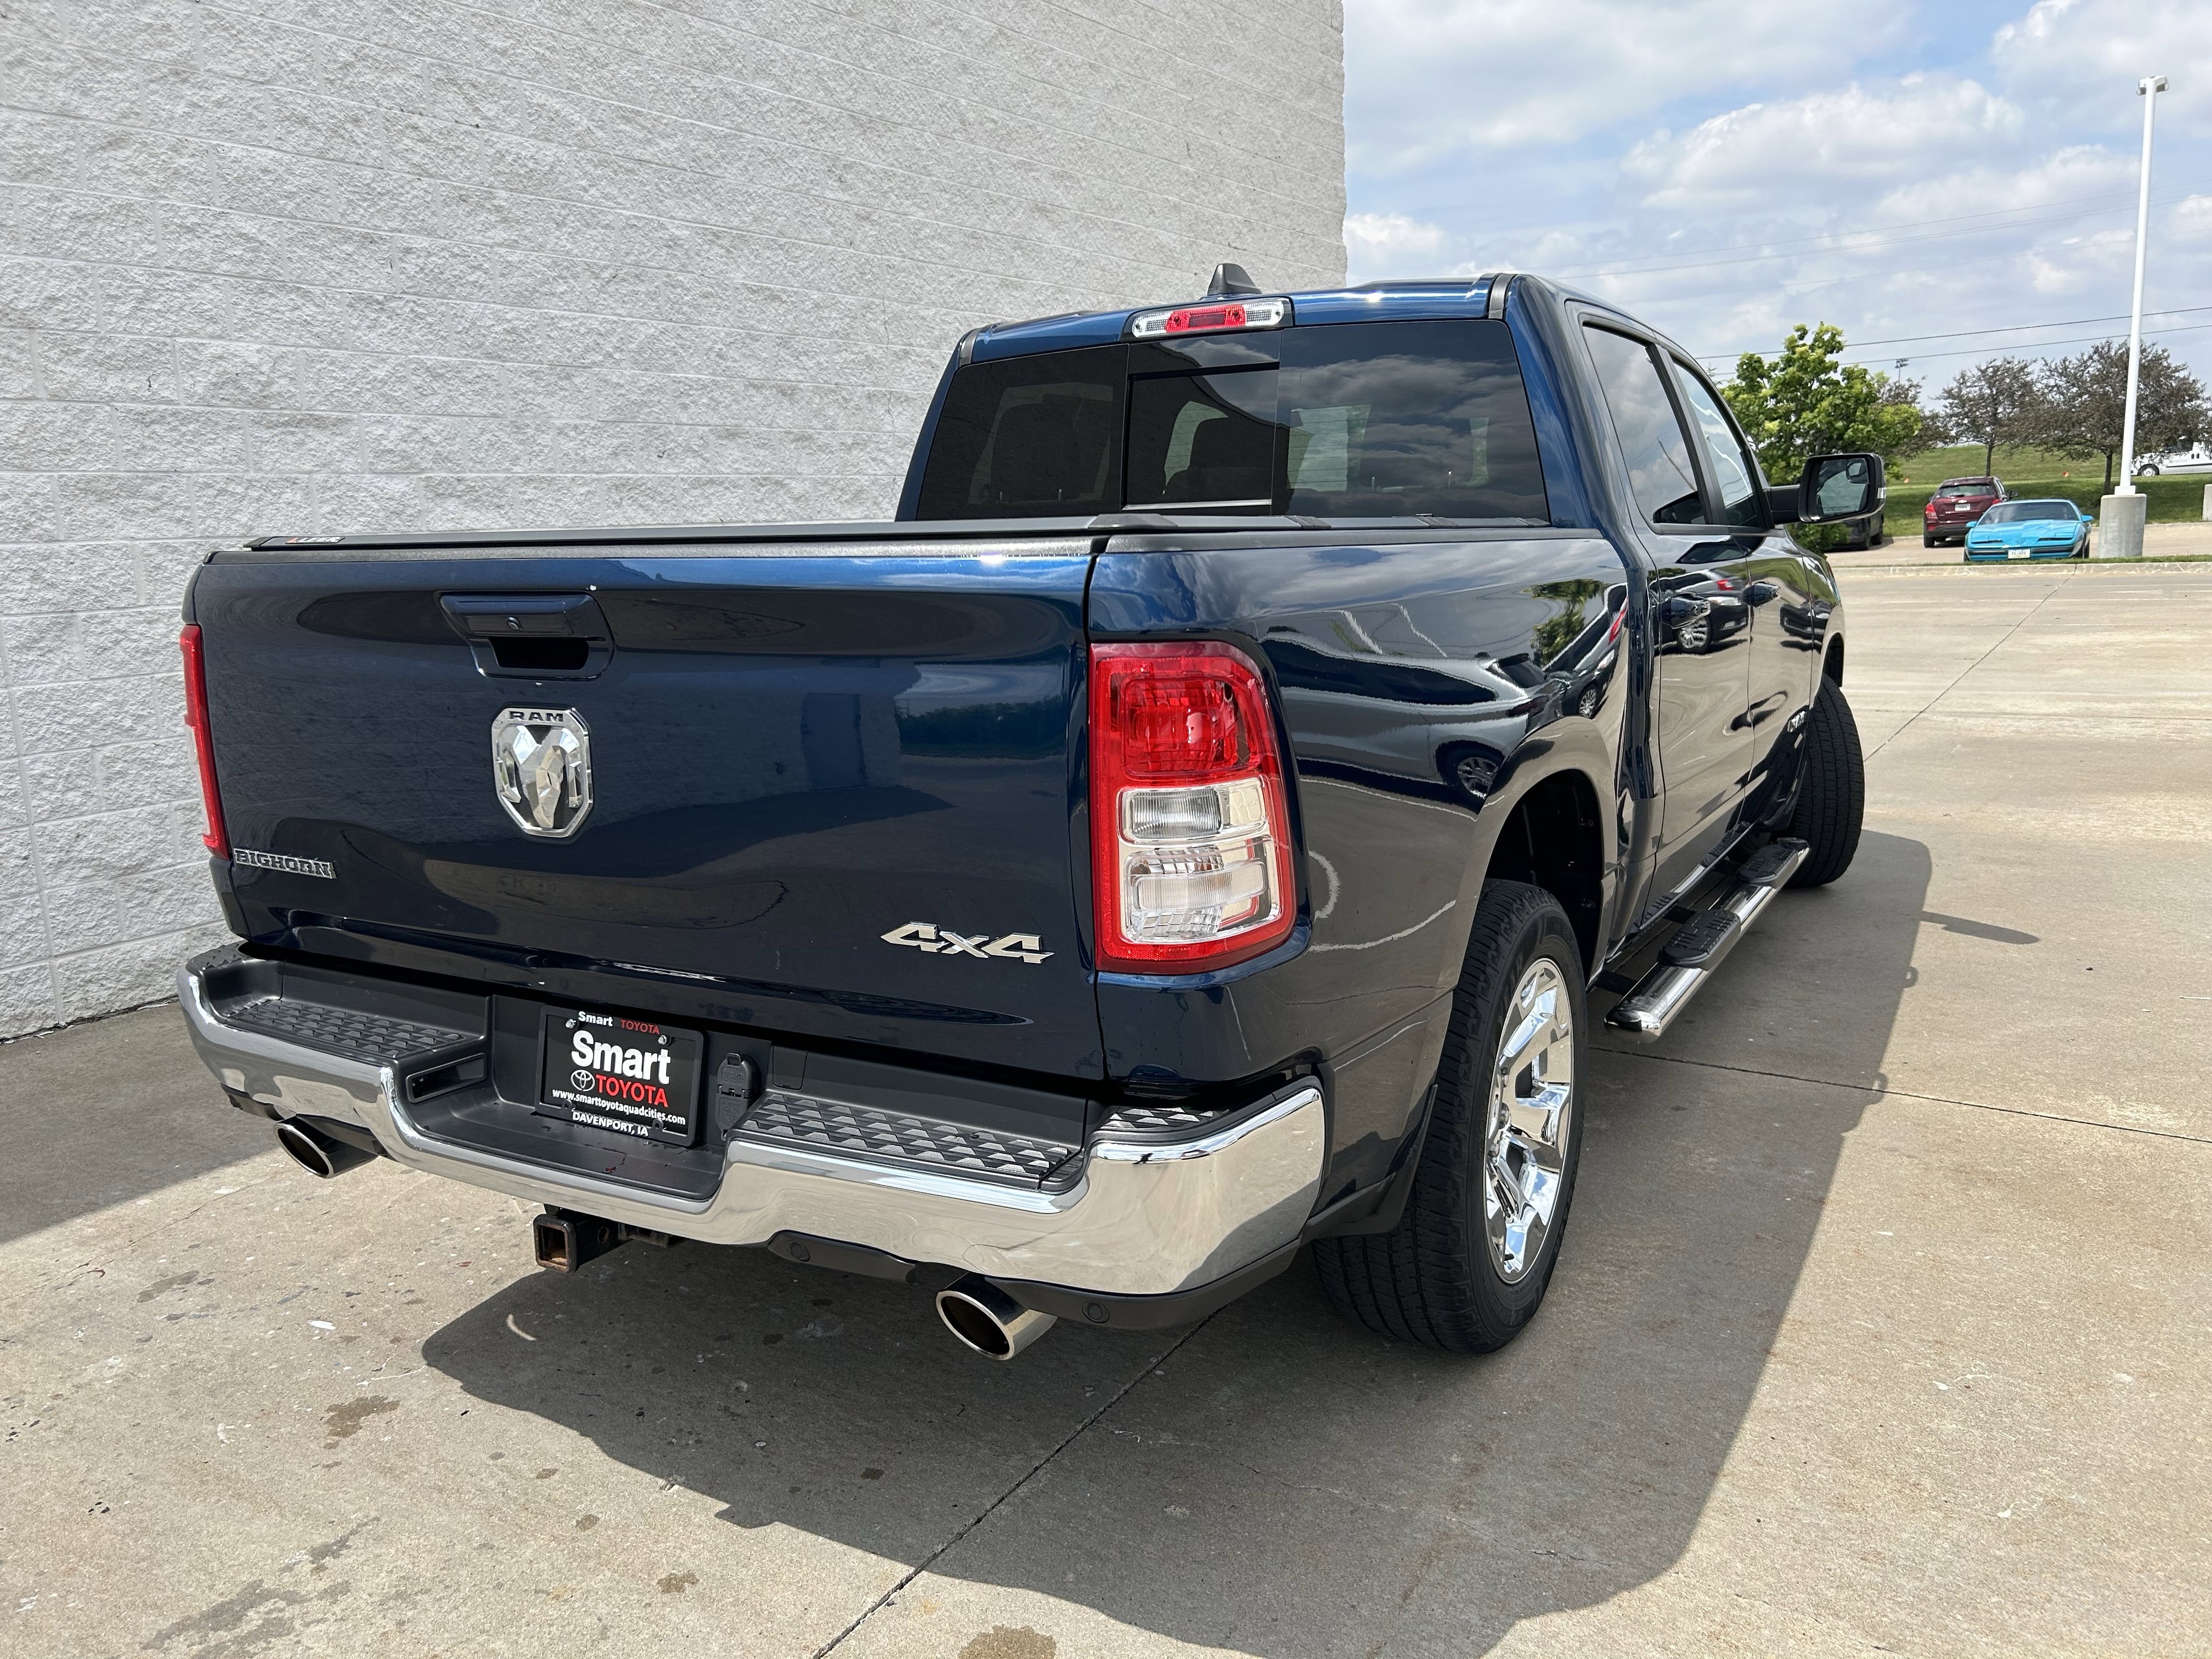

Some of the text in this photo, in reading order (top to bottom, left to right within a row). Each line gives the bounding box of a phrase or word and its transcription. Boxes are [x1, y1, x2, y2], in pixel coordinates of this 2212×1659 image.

[509, 711, 563, 723] RAM
[234, 848, 334, 879] BIGHORN
[578, 1011, 660, 1035] Smart TOYOTA
[571, 1030, 671, 1085] Smart
[552, 1088, 686, 1125] www.smarttoyotaquadcities.com
[595, 1074, 669, 1108] TOYOTA
[572, 1111, 649, 1137] DAVENPORT, IA
